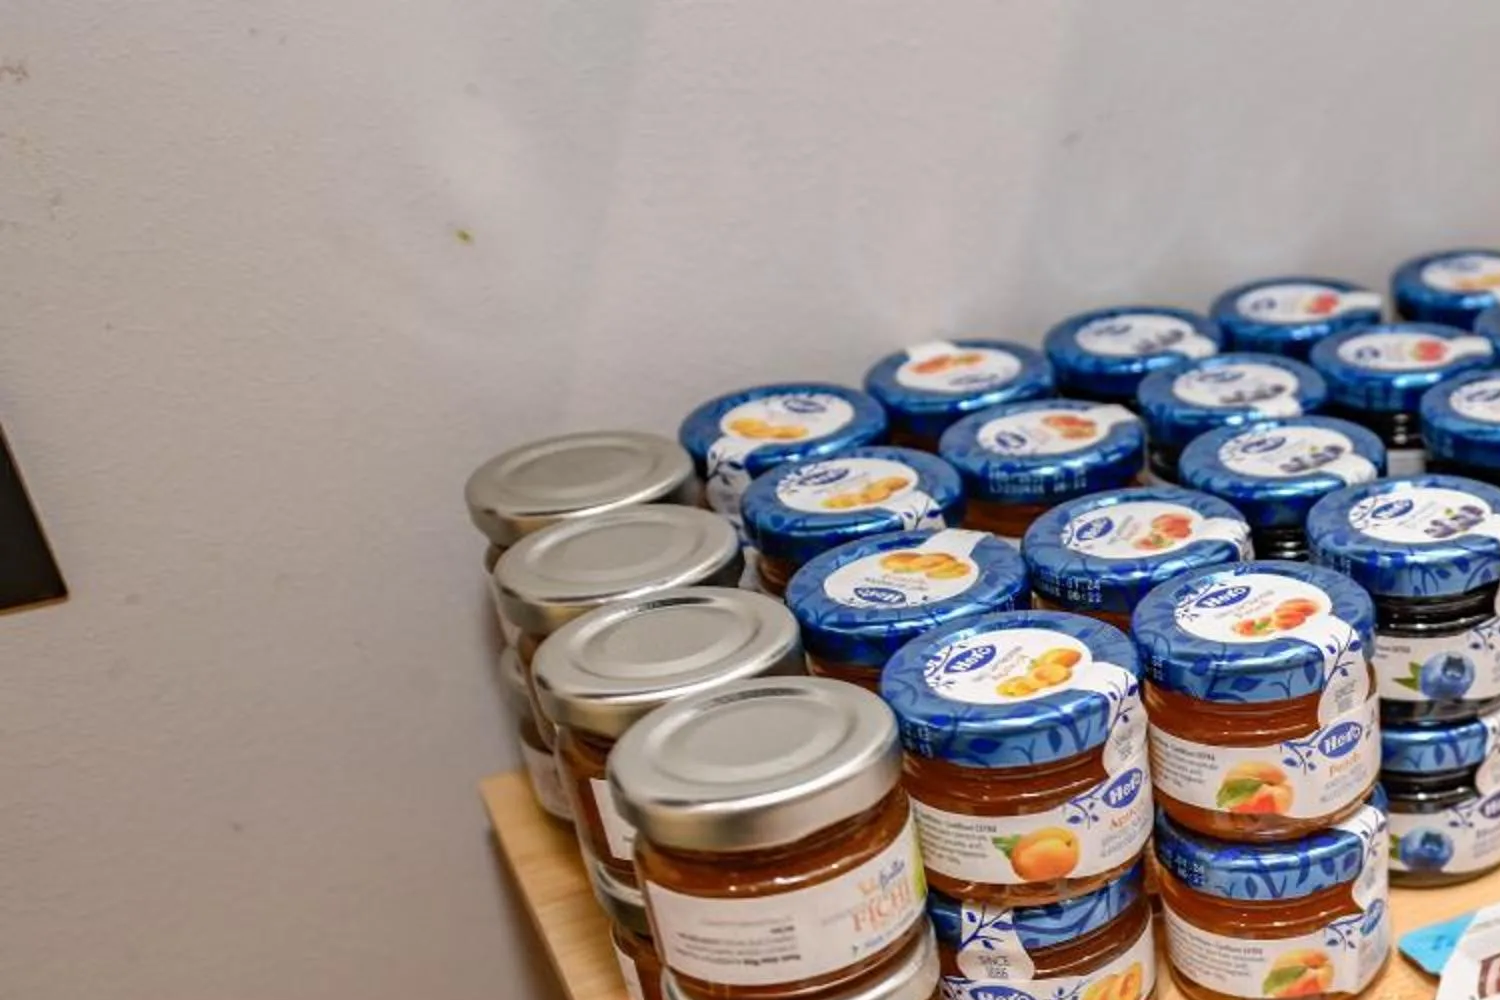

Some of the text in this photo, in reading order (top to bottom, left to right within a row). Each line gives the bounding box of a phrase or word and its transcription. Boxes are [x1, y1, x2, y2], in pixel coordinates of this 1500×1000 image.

[1204, 586, 1247, 607] Hero
[955, 646, 991, 671] Hero
[1325, 726, 1361, 753] Hero
[1110, 772, 1140, 804] Hero
[978, 955, 1009, 966] SINCE
